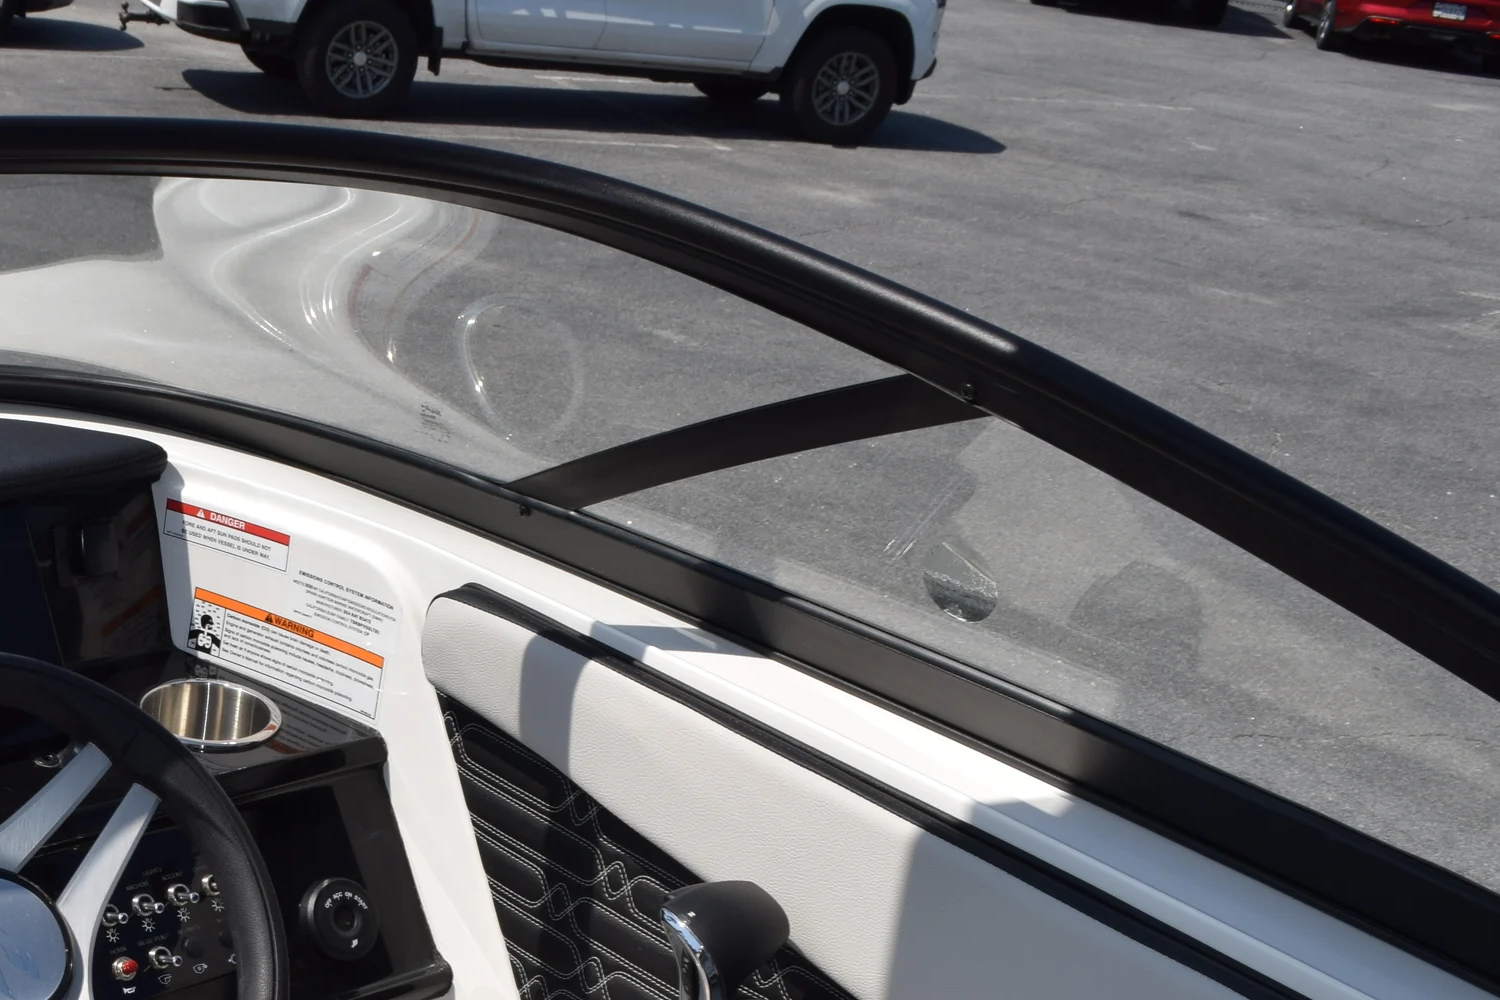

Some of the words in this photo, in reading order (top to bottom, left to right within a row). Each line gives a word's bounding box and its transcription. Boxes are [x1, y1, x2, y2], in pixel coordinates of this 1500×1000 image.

[210, 512, 245, 530] DANGER
[183, 520, 194, 528] FORE
[196, 524, 206, 532] AND
[228, 534, 240, 542] PADS
[242, 538, 260, 548] SHOULD
[189, 530, 201, 538] USED
[204, 535, 217, 543] WHEN
[243, 547, 259, 556] UNDER
[299, 570, 323, 583] EMISSIONS
[324, 579, 345, 591] CONTROL
[346, 587, 363, 598] SYSTEM
[365, 595, 394, 610] INFORMATION
[274, 617, 314, 638] WARNING
[359, 616, 371, 624] BOATS
[354, 895, 368, 909] START
